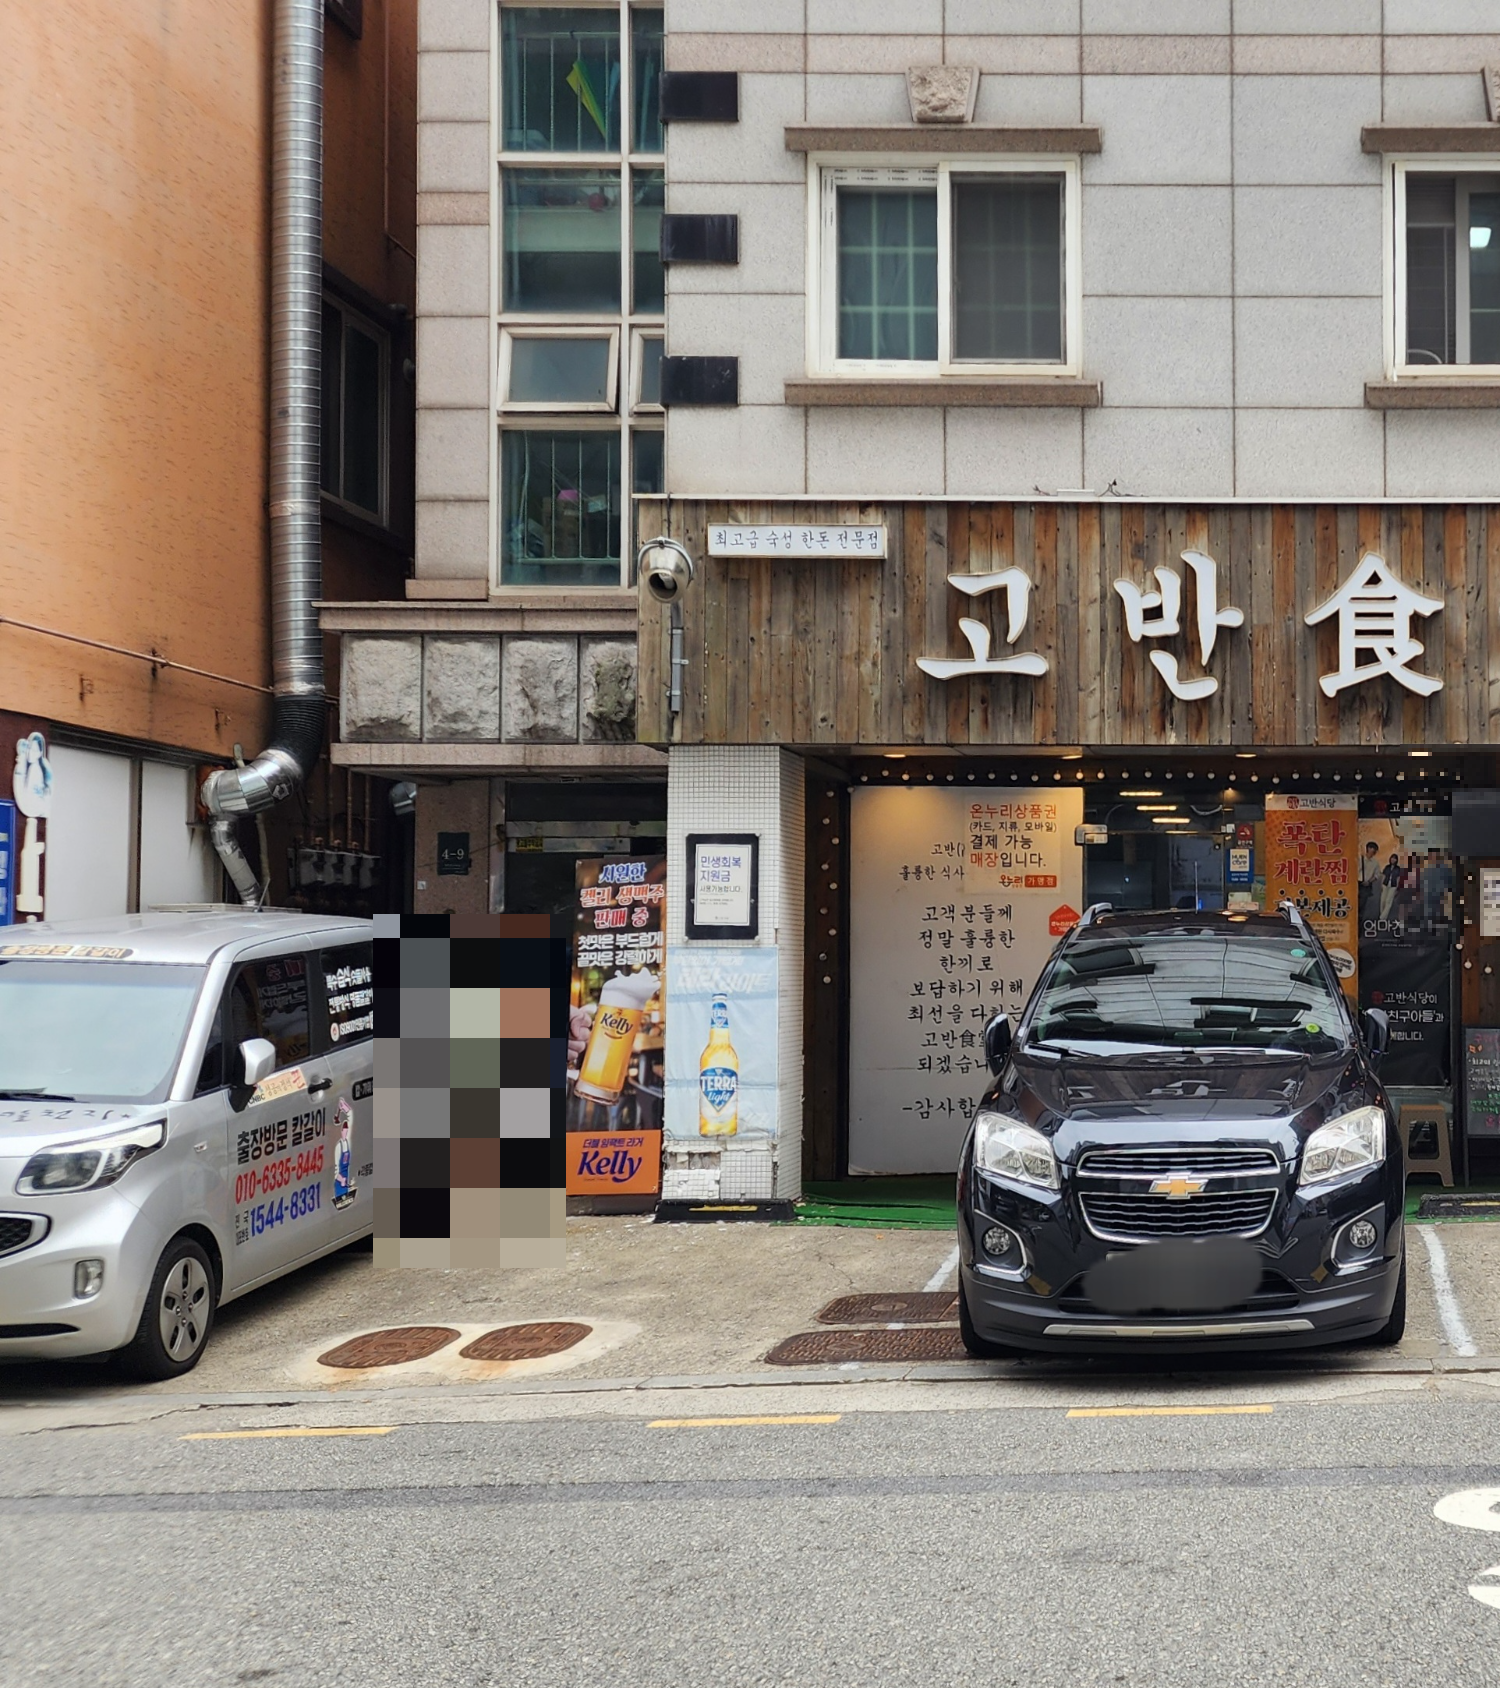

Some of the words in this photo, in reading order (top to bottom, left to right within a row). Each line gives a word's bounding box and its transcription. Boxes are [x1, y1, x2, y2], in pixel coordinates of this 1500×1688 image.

[714, 529, 759, 549] 최고급
[765, 530, 793, 550] 숙성
[801, 529, 830, 549] 한돈
[836, 530, 878, 550] 전문점
[970, 803, 1057, 819] 온누리상품권
[1300, 797, 1336, 808] 고반식당
[969, 821, 995, 832] (카드,
[998, 821, 1021, 832] 지류,
[1024, 821, 1057, 832] 모바일)
[970, 835, 998, 850] 결제
[1005, 834, 1033, 849] 가능
[1277, 820, 1346, 856] 폭탄
[442, 848, 464, 860] 4-9
[930, 841, 965, 857] 고반(
[701, 856, 741, 868] 민생회복
[970, 852, 1047, 868] 매장입니다.
[599, 863, 646, 883] 시원한
[701, 870, 730, 882] 지원금
[899, 865, 935, 881] 훌륭한
[941, 865, 965, 881] 식사
[1273, 857, 1349, 885] 계란찜
[580, 886, 612, 907] 켈리
[615, 884, 665, 905] 생맥주
[594, 907, 628, 928] 판매
[632, 907, 649, 927] 중
[578, 934, 614, 950] 첫맛은
[616, 931, 663, 947] 부드럽게
[918, 929, 954, 949] 정말
[960, 929, 1015, 949] 훌륭한
[577, 951, 613, 967] 끝맛은
[615, 949, 662, 965] 강렬하게
[909, 979, 982, 999] 보답하기
[989, 979, 1023, 997] 위해
[1384, 991, 1437, 1004] 고반식당이
[600, 1012, 633, 1036] Kelly
[907, 1004, 964, 1024] 최선을
[917, 1054, 989, 1074] 되겠습니
[701, 1075, 738, 1092] TERRA
[902, 1097, 977, 1120] -감사합
[237, 1119, 288, 1166] 출장방문
[292, 1107, 326, 1147] 칼갈이
[583, 1139, 599, 1148] 더블
[627, 1137, 644, 1147] 라거
[235, 1145, 325, 1205] 010-6335-8445
[577, 1151, 642, 1183] Kelly
[250, 1181, 321, 1237] 1544-8331
